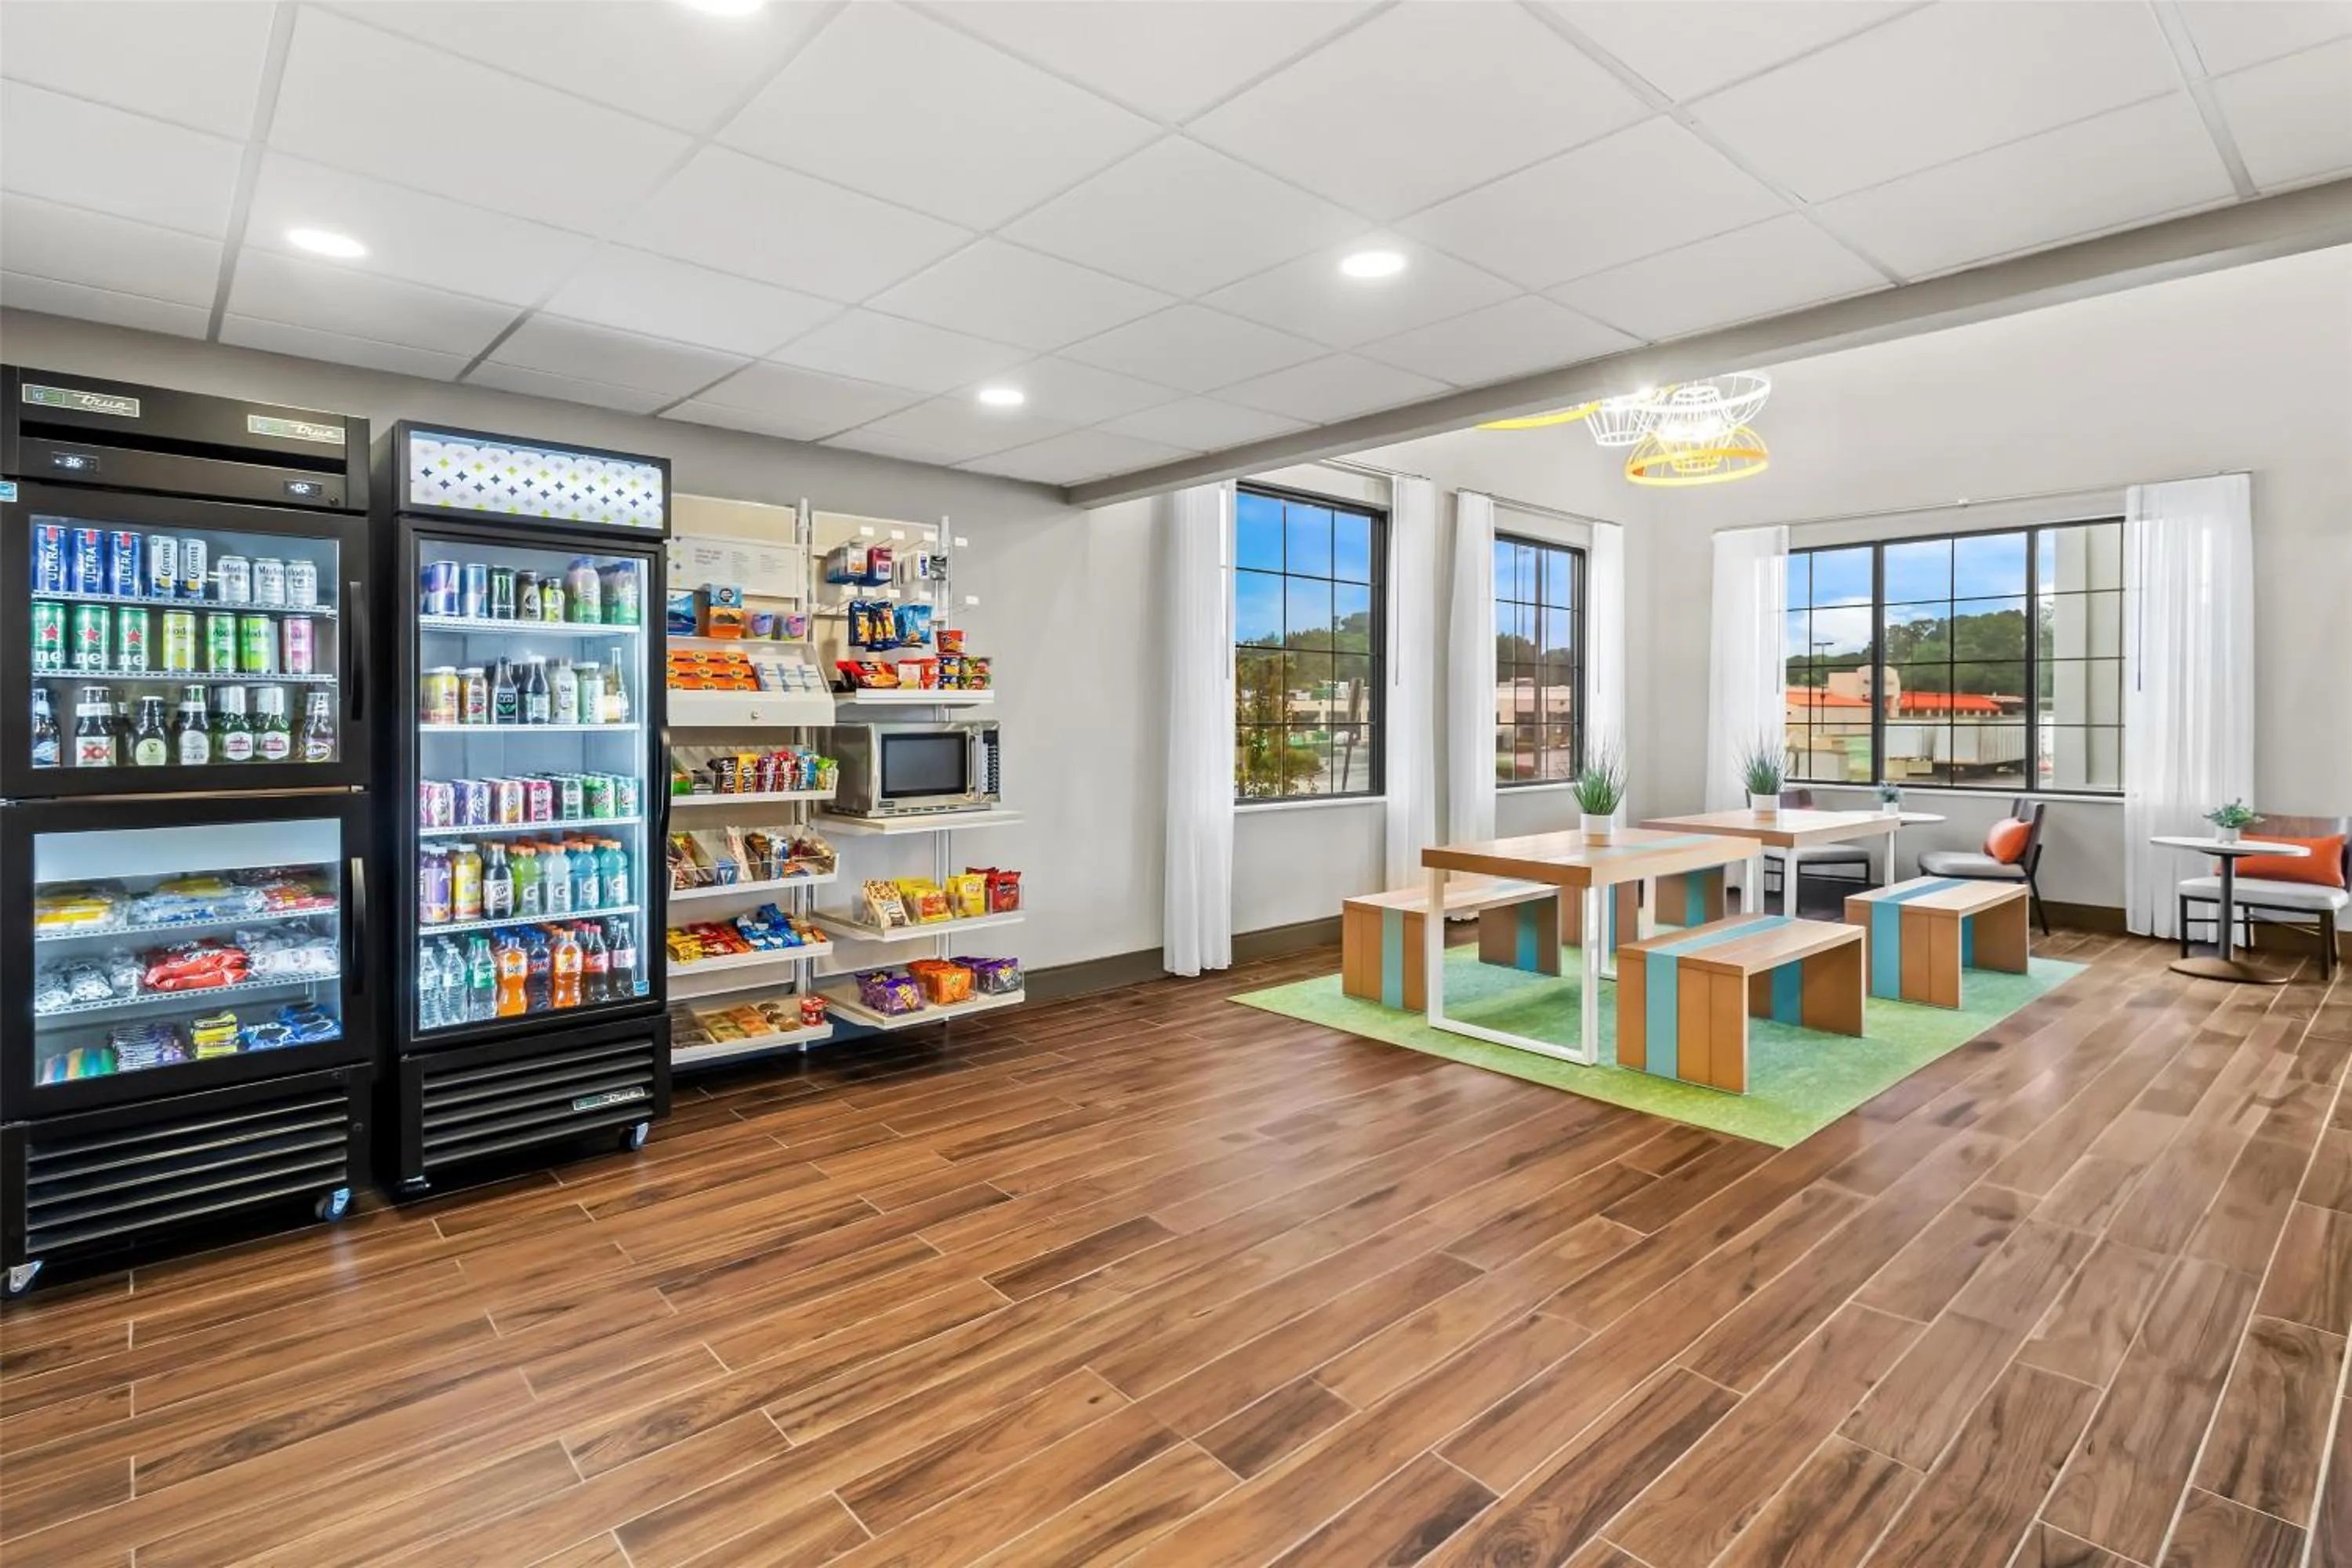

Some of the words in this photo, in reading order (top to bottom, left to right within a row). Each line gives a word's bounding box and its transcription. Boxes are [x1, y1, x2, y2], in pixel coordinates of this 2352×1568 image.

[48, 543, 59, 582] ULTRA
[85, 546, 96, 583] ULTRA
[120, 550, 132, 584] ULTRA
